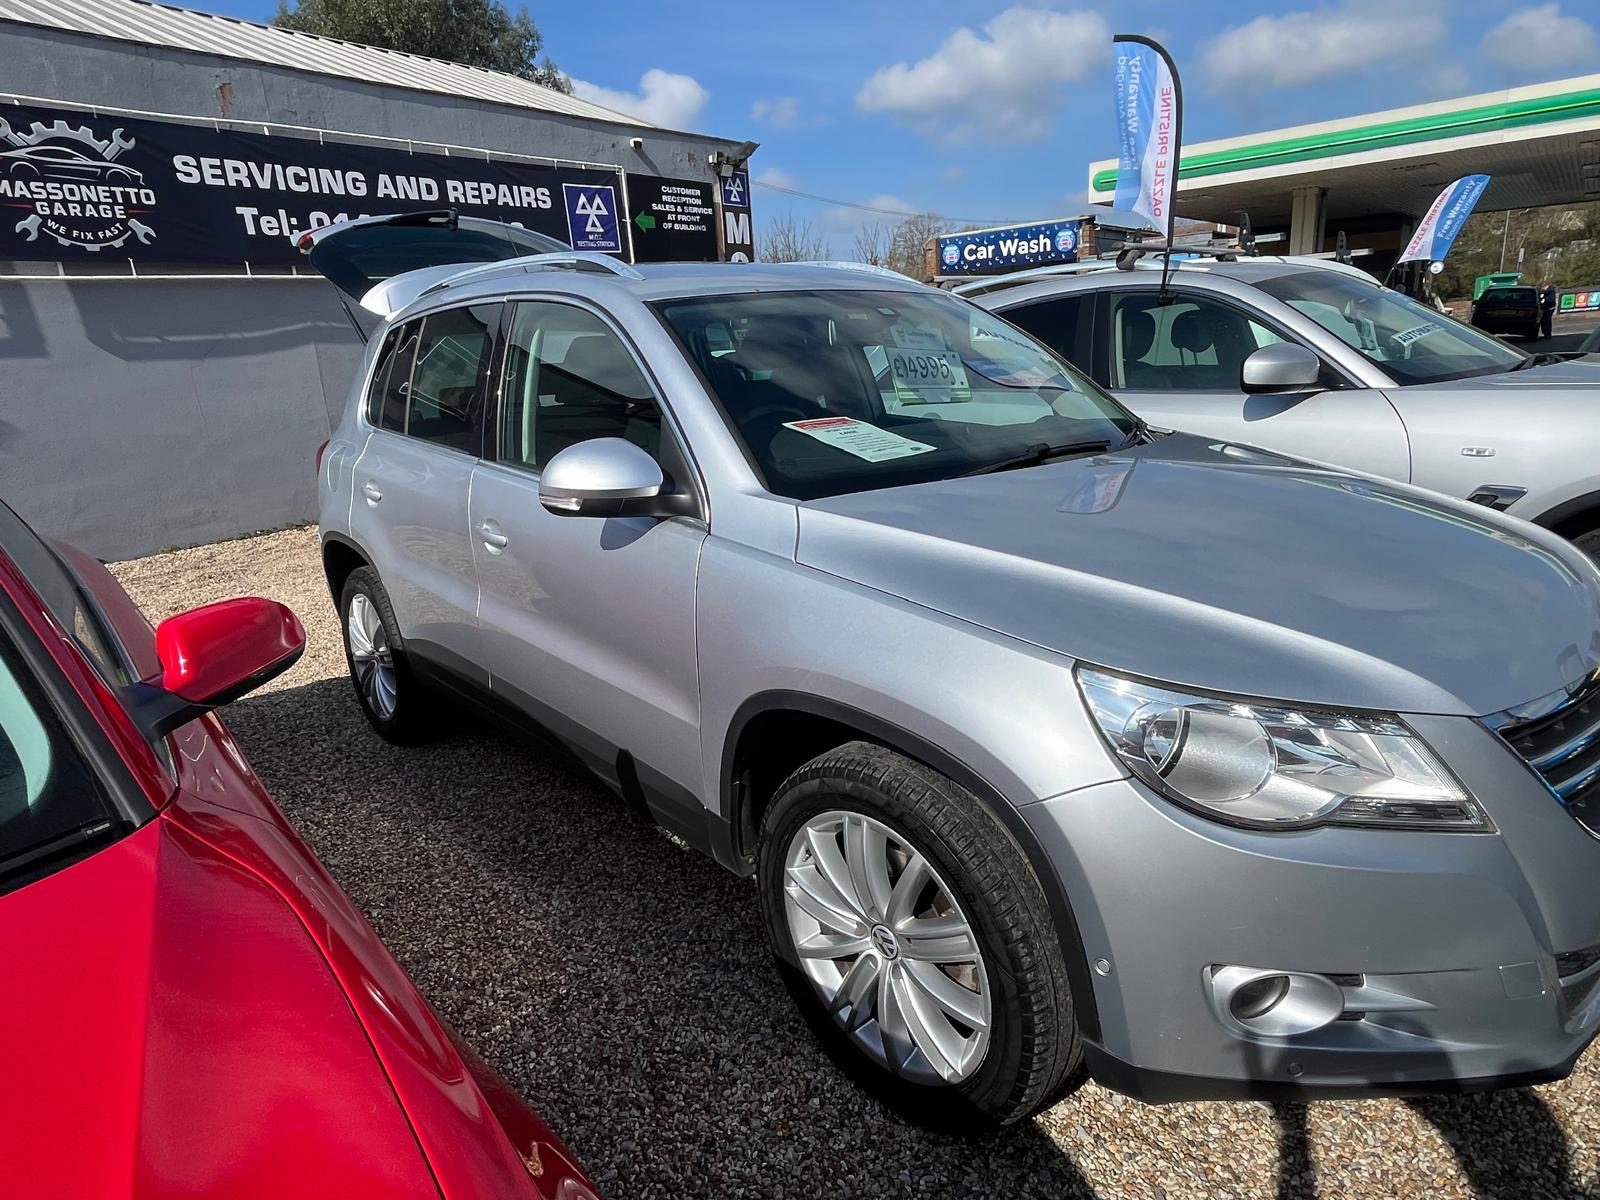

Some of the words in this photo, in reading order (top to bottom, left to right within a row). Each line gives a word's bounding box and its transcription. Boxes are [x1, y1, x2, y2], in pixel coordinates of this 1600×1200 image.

[172, 154, 367, 197] SERVICING
[377, 173, 439, 202] AND
[445, 179, 552, 209] REPAIRS
[661, 185, 701, 196] CUSTOMER
[0, 179, 156, 205] MASSONETTO
[662, 195, 702, 205] RECEPTION
[35, 201, 127, 219] GARAGE
[651, 203, 675, 212] SALES
[684, 206, 713, 215] SERVICE
[667, 213, 676, 221] AT
[677, 214, 700, 222] FRONT
[1437, 219, 1453, 238] Free
[1448, 180, 1476, 219] Warranty
[47, 218, 66, 235] WE
[72, 230, 94, 240] FIX
[98, 222, 124, 240] FAST
[235, 206, 299, 237] Tel:
[662, 222, 673, 230] OF
[674, 223, 707, 232] BUILDING
[963, 243, 995, 261] Car
[998, 234, 1051, 257] Wash
